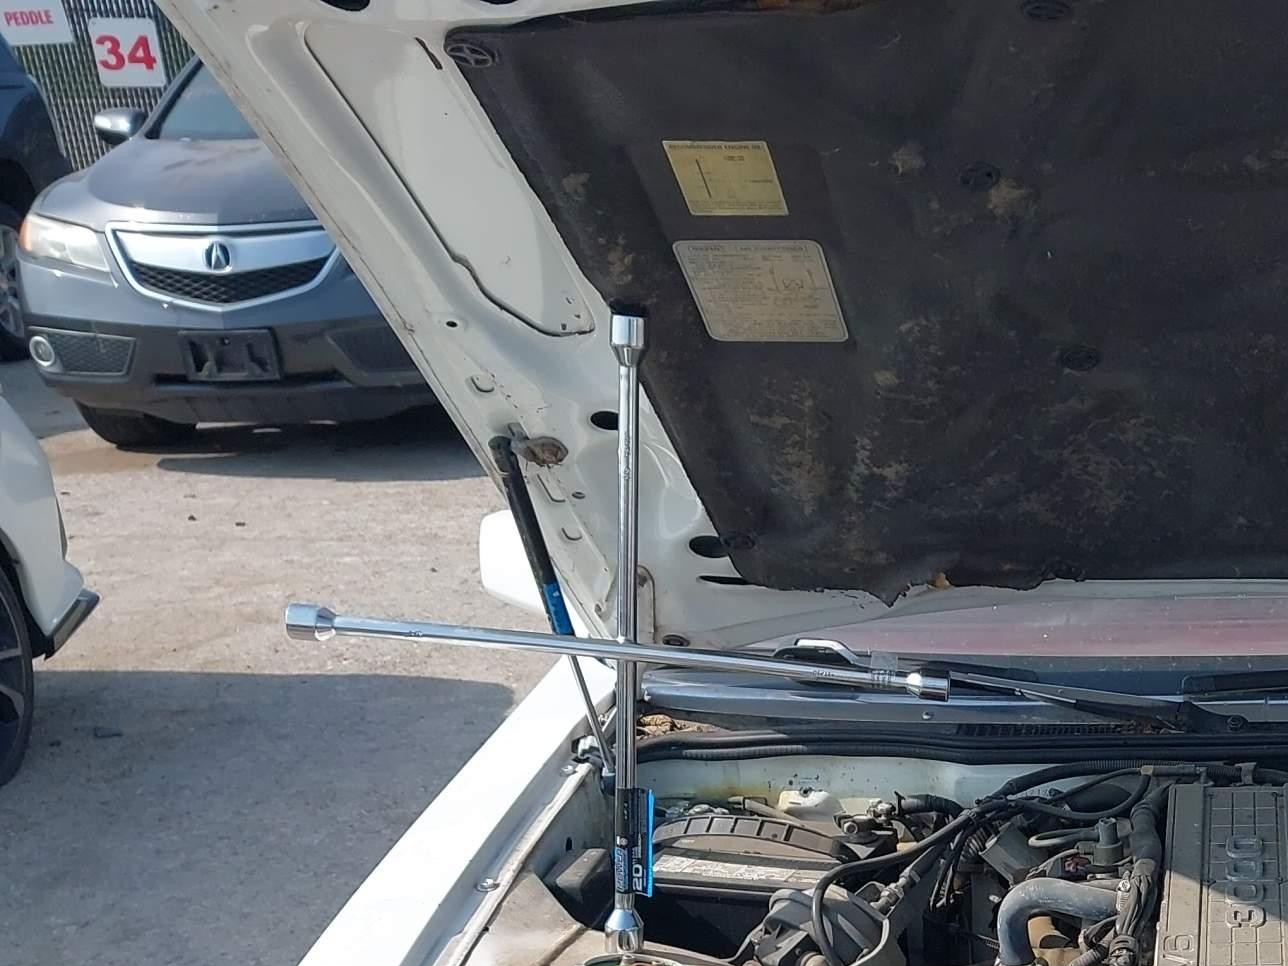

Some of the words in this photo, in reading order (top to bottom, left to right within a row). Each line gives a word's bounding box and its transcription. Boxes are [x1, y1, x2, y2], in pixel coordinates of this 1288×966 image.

[4, 9, 54, 26] PEDDLE
[95, 34, 157, 72] 34
[1225, 836, 1266, 928] 3000
